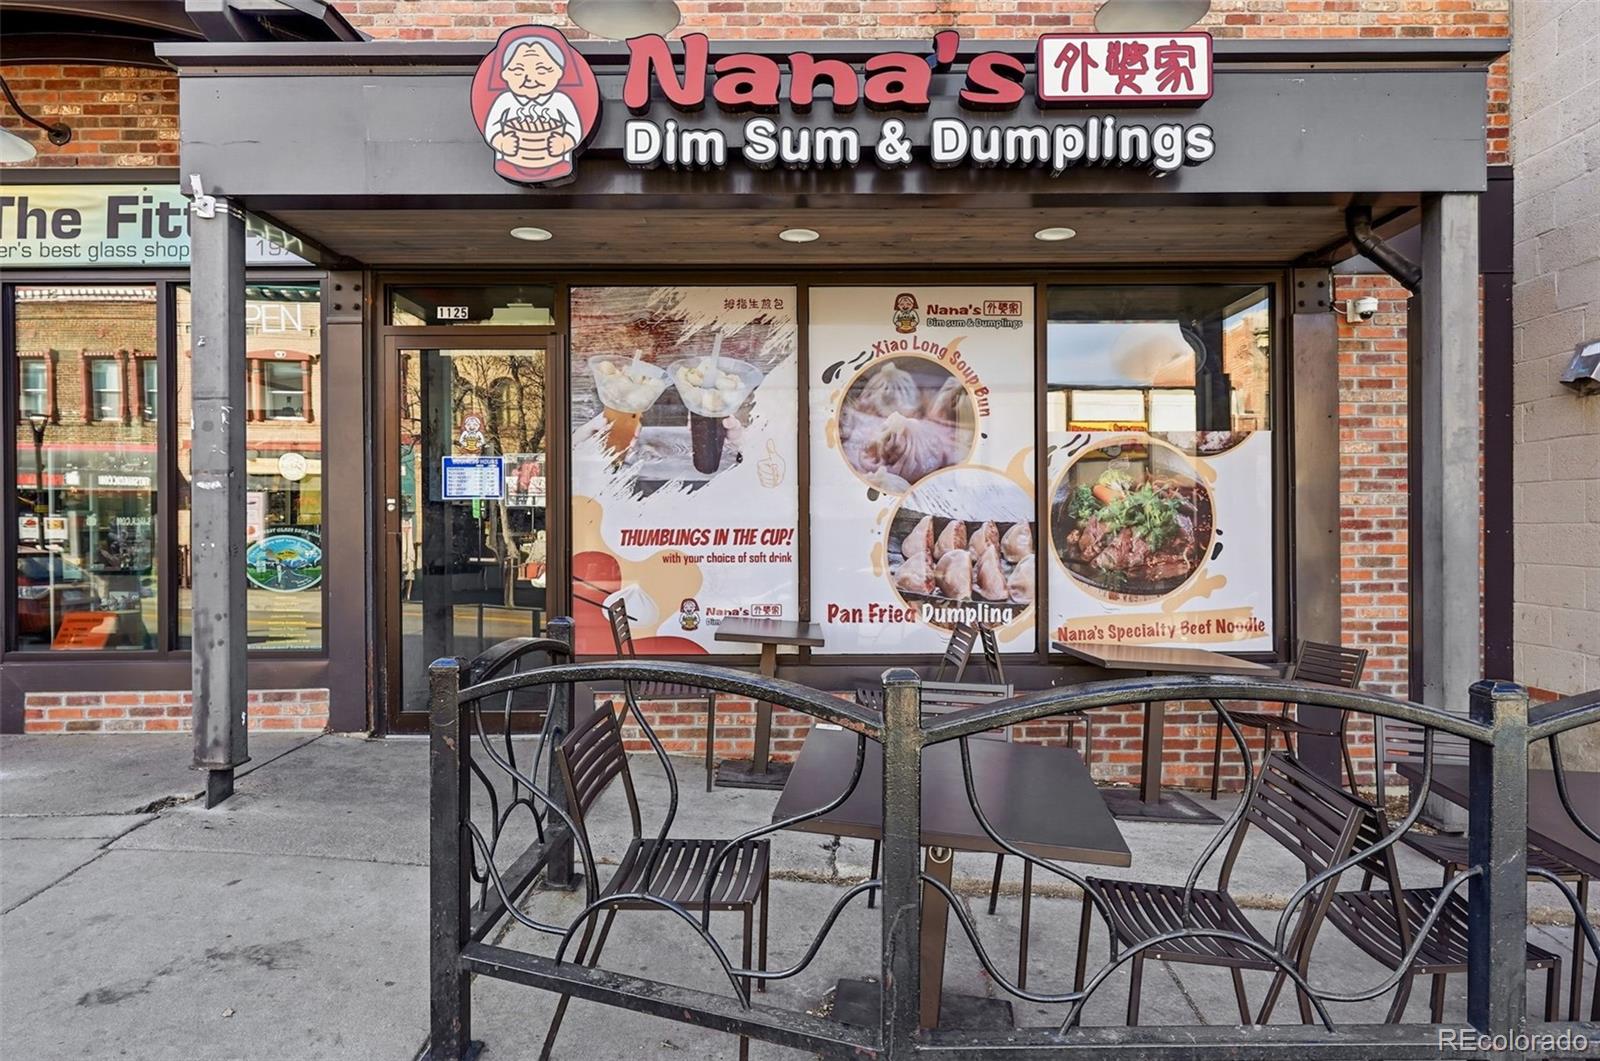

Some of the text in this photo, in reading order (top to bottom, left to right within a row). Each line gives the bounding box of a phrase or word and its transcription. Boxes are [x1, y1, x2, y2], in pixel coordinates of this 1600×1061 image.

[623, 30, 1028, 112] Nana's
[1053, 39, 1197, 95] 外婆家
[624, 114, 1216, 172] Dim Sum & Dumplings
[39, 241, 81, 258] best
[88, 241, 137, 262] glass
[144, 241, 190, 261] shop
[256, 239, 290, 256] 19
[439, 306, 468, 319] 1125
[723, 297, 785, 310] 拇指生煎包
[926, 303, 982, 316] Nana's
[246, 303, 302, 333] PEN
[926, 317, 946, 328] Dim
[975, 318, 1024, 330] Dumplings
[872, 335, 991, 417] Xiao Long Soup Bun
[620, 528, 795, 546] THUMBLINGS IN THE CUP!
[662, 551, 793, 566] with your choice of soft drink
[705, 607, 750, 616] Nana's
[827, 602, 1013, 626] Pan Fried Dumpling
[1057, 625, 1105, 642] Nana's
[1108, 621, 1176, 642] Specialty
[1180, 619, 1211, 636] Beef
